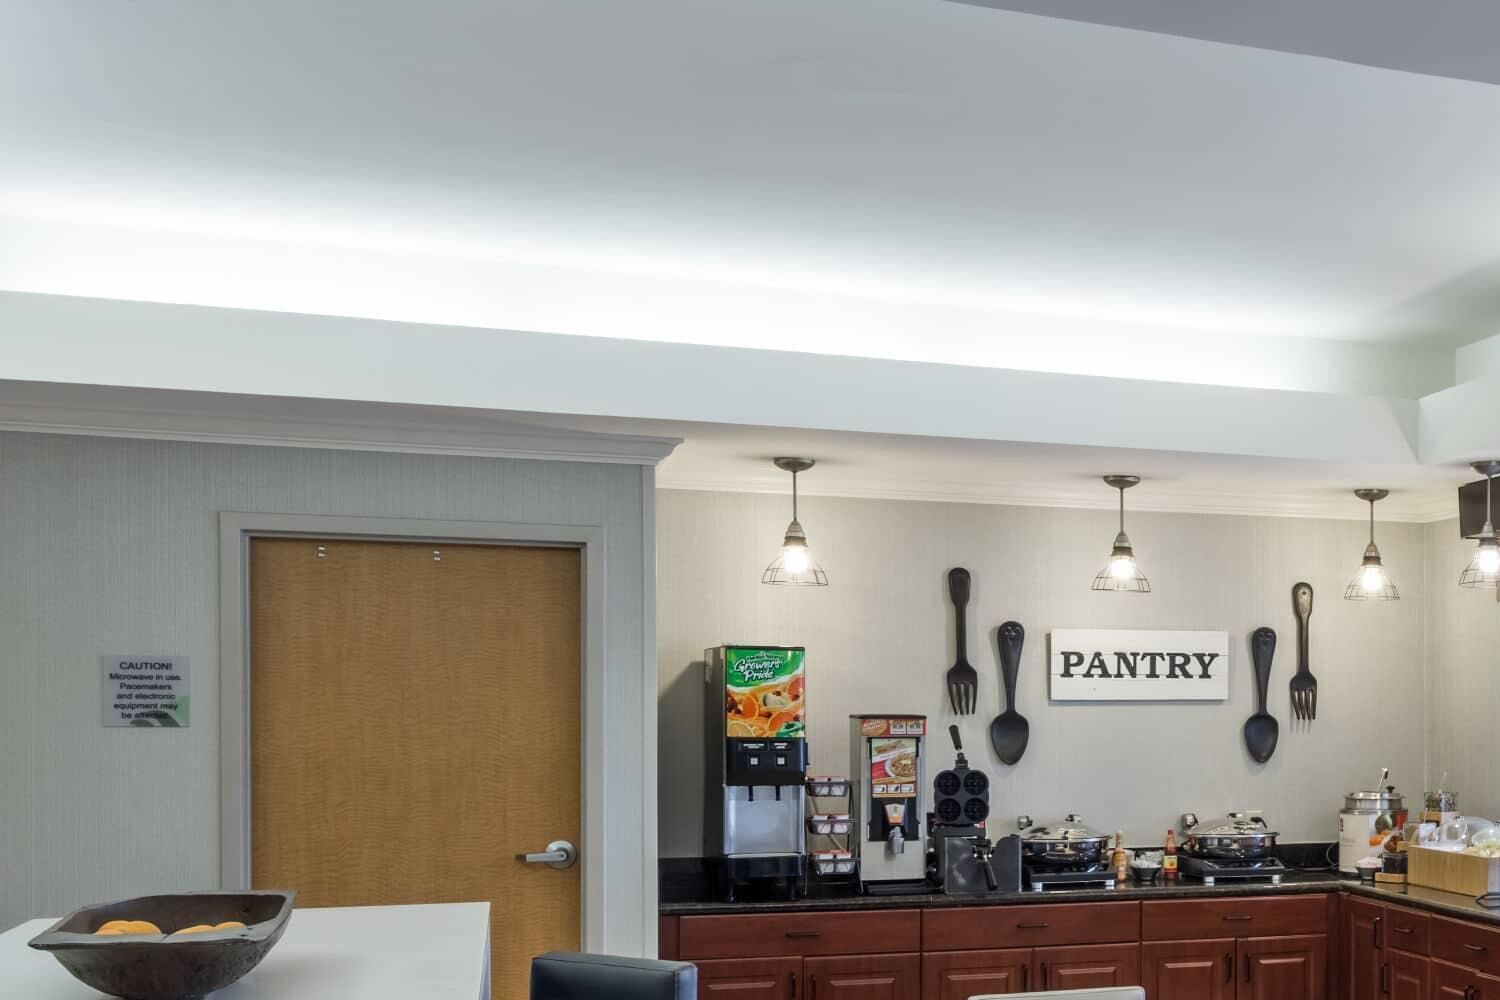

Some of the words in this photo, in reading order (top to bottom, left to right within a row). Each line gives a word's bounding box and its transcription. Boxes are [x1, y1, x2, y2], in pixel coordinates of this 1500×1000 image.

[119, 661, 173, 671] CAUTION!
[1060, 651, 1219, 679] PANTRY
[743, 669, 774, 682] Pride
[119, 682, 173, 690] Pacemakers
[116, 692, 133, 700] and
[134, 692, 176, 700] electronic
[113, 702, 158, 710] equipment
